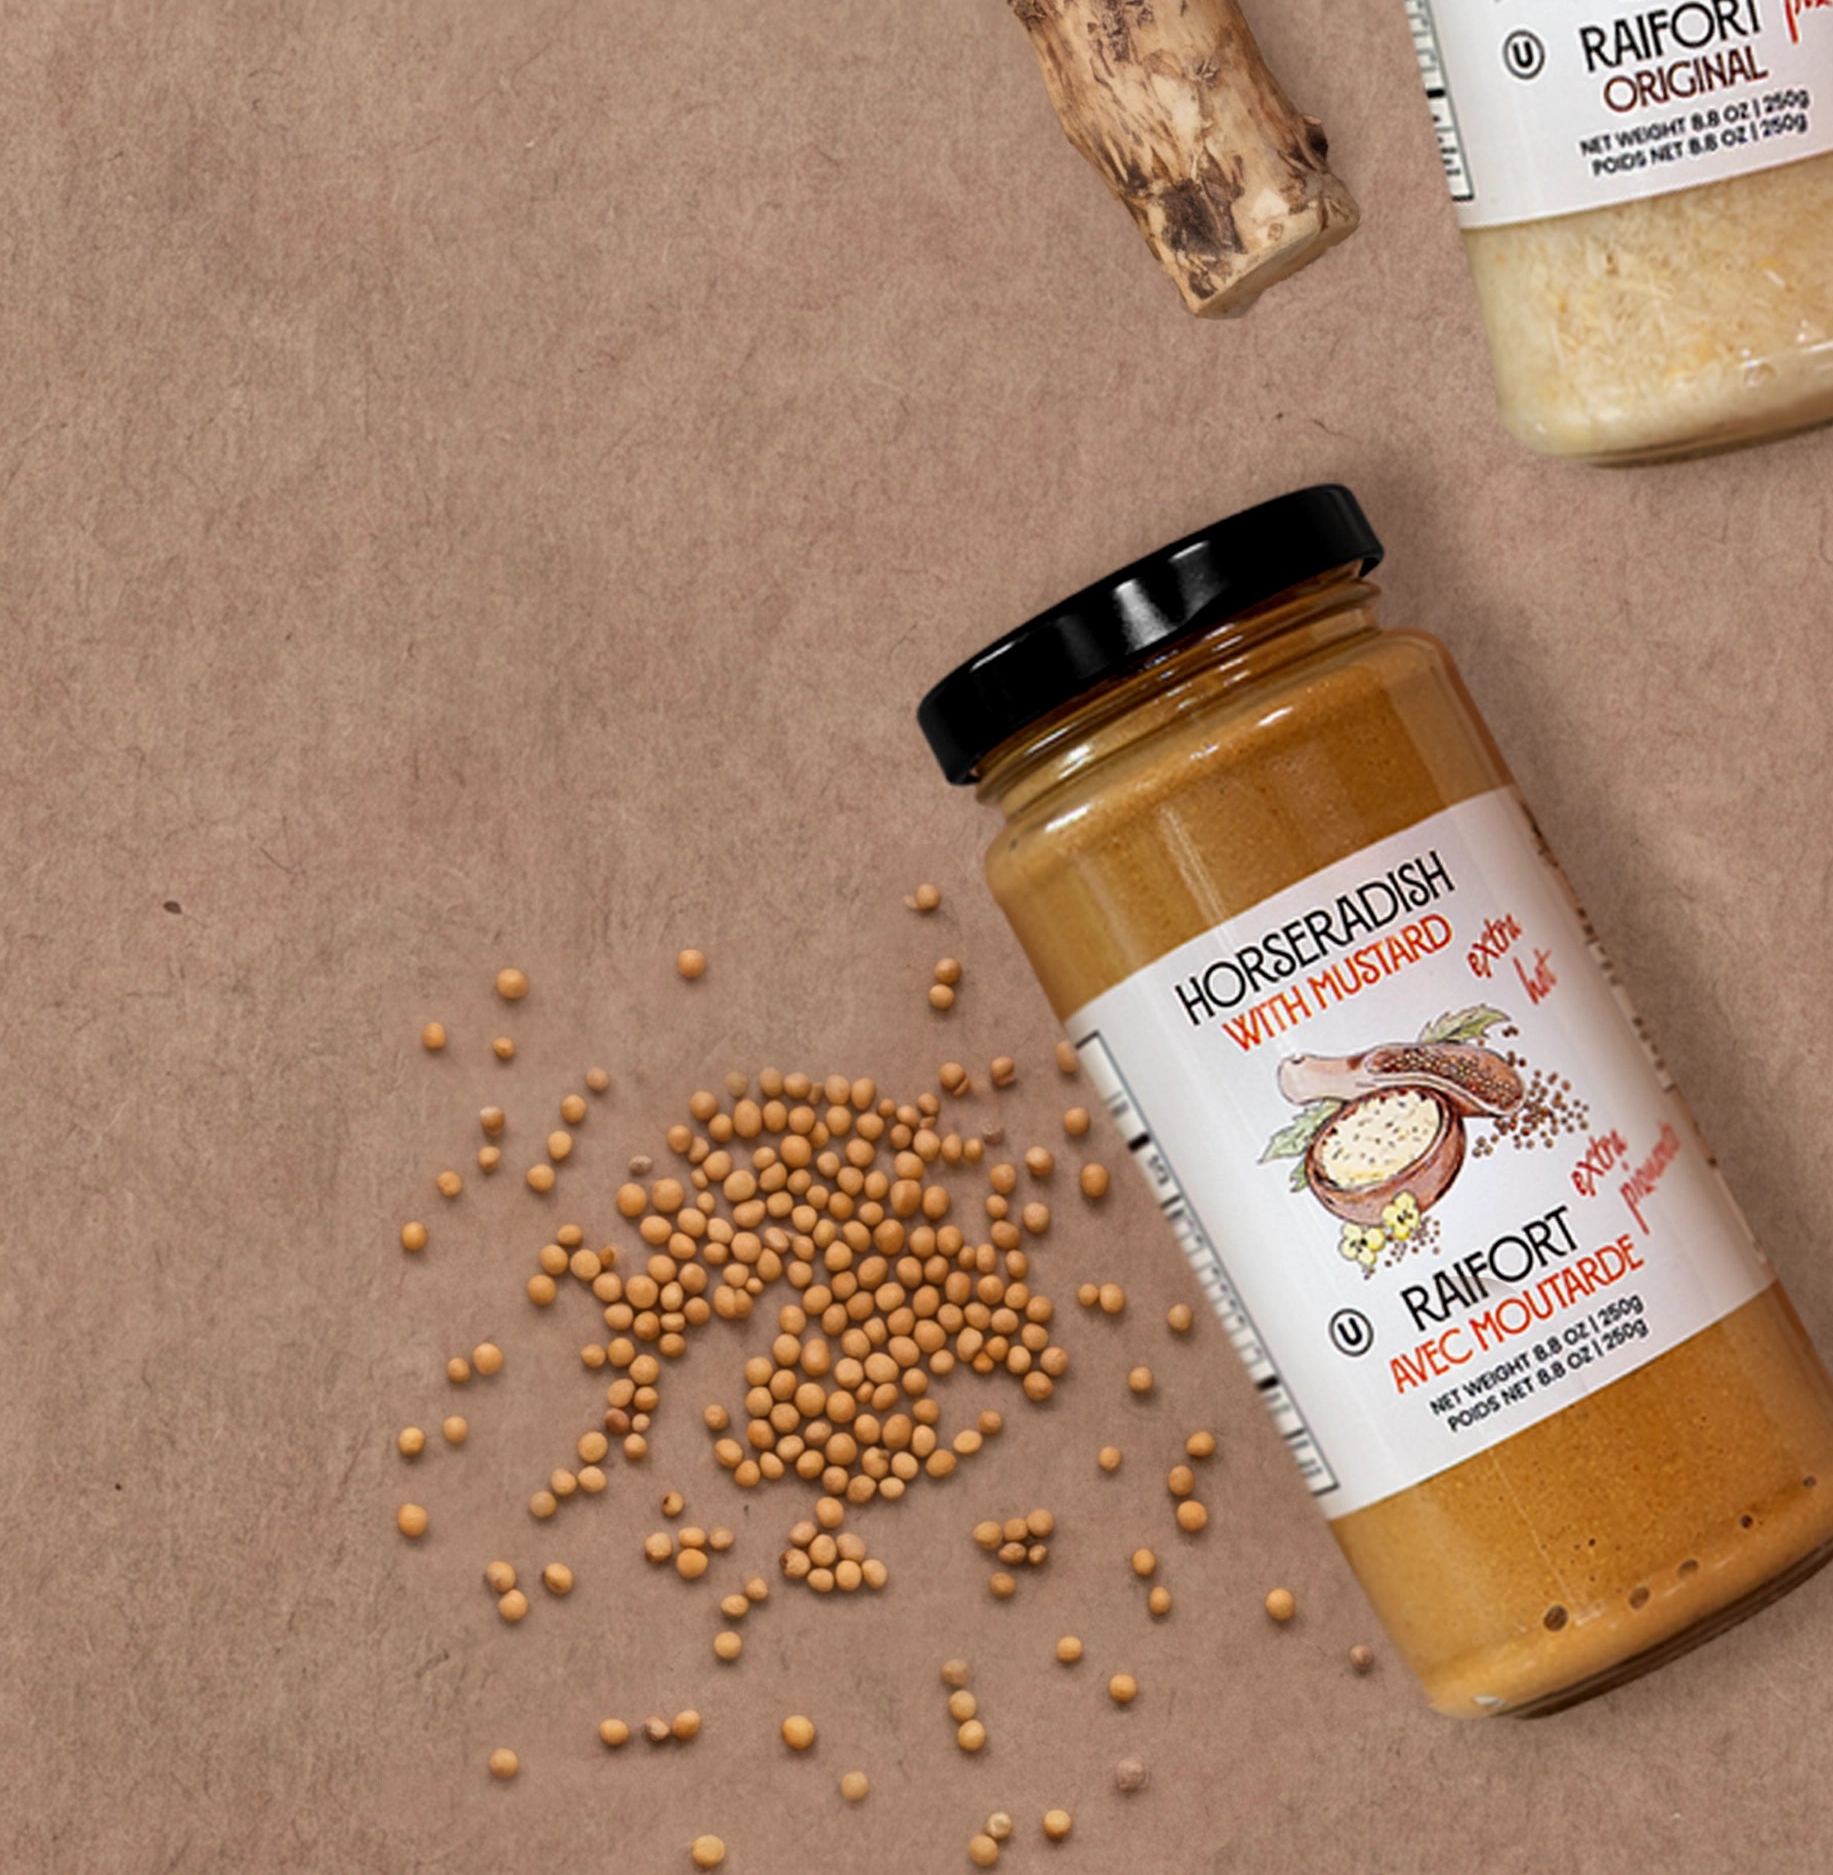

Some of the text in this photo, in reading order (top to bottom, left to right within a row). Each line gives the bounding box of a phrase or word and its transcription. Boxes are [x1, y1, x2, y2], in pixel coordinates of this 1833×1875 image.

[1580, 134, 1612, 156] NET
[1615, 116, 1685, 148] WEIGHT
[1691, 109, 1721, 130] 8.8
[1724, 102, 1750, 123] OZ
[1763, 89, 1809, 113] 250g
[1603, 45, 1769, 113] ORIGINAL
[1592, 151, 1647, 176] POIDS
[1650, 141, 1683, 165] NET
[1688, 134, 1718, 154] 8.8
[1721, 126, 1747, 146] OZ
[1760, 113, 1808, 134] 250g
[1174, 849, 1456, 1027] HORSERADISH
[1221, 912, 1454, 1053] WITH MUSTARD
[1467, 913, 1522, 979] extra
[1513, 948, 1557, 1005] hot
[1571, 1129, 1628, 1197] extra
[1400, 1205, 1580, 1333] RAIFORT
[1388, 1234, 1645, 1395] AVEC MOUTARDE
[1429, 1389, 1461, 1416] NET
[1463, 1353, 1531, 1398] WEIGHT
[1532, 1336, 1562, 1362] 8.8
[1563, 1321, 1590, 1346] OZ
[1598, 1295, 1643, 1325] 250g
[1447, 1398, 1500, 1432] POIDS
[1500, 1377, 1535, 1405] NET
[1537, 1362, 1566, 1386] 8.8
[1566, 1345, 1593, 1370] OZ
[1601, 1319, 1648, 1351] 250g
